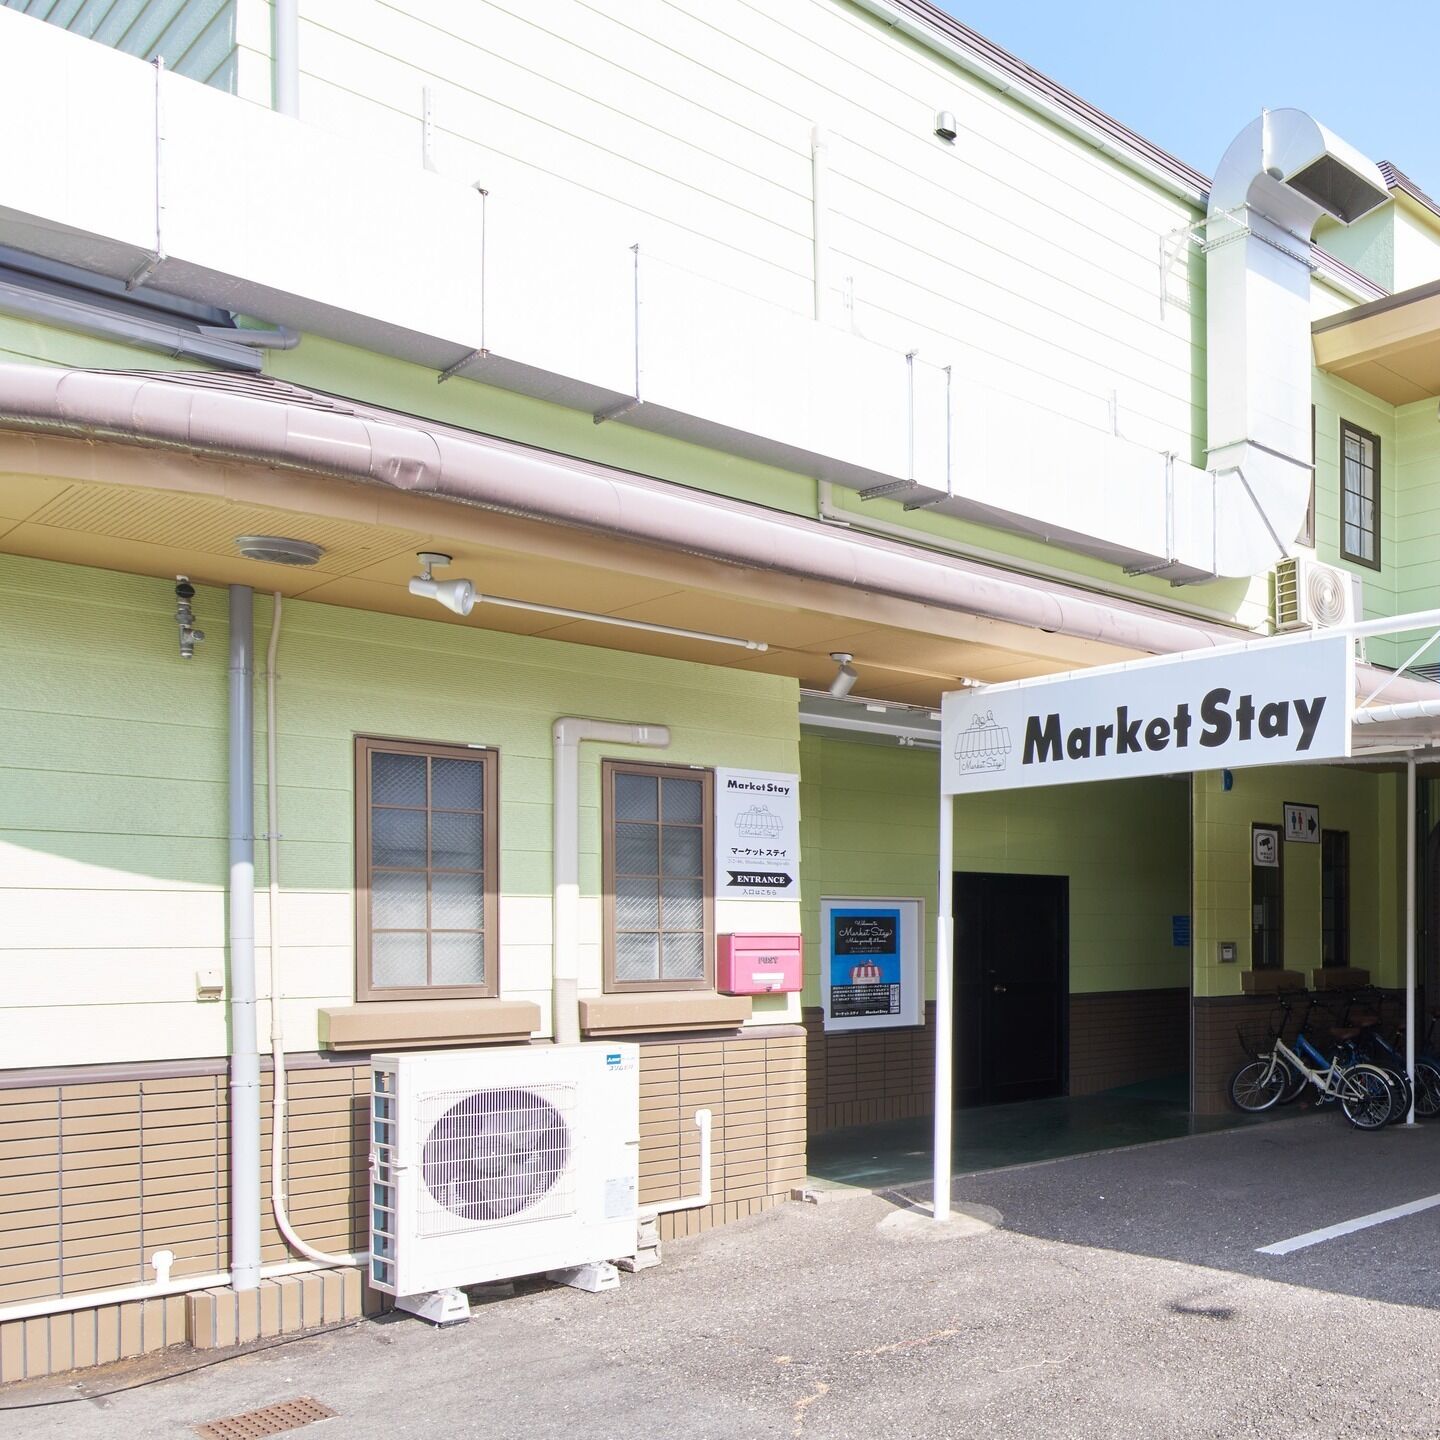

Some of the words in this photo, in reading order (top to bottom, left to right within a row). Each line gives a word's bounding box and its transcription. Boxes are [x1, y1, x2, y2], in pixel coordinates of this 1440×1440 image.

[737, 875, 785, 884] ENTRANCE
[743, 888, 777, 896] 入口はこちら
